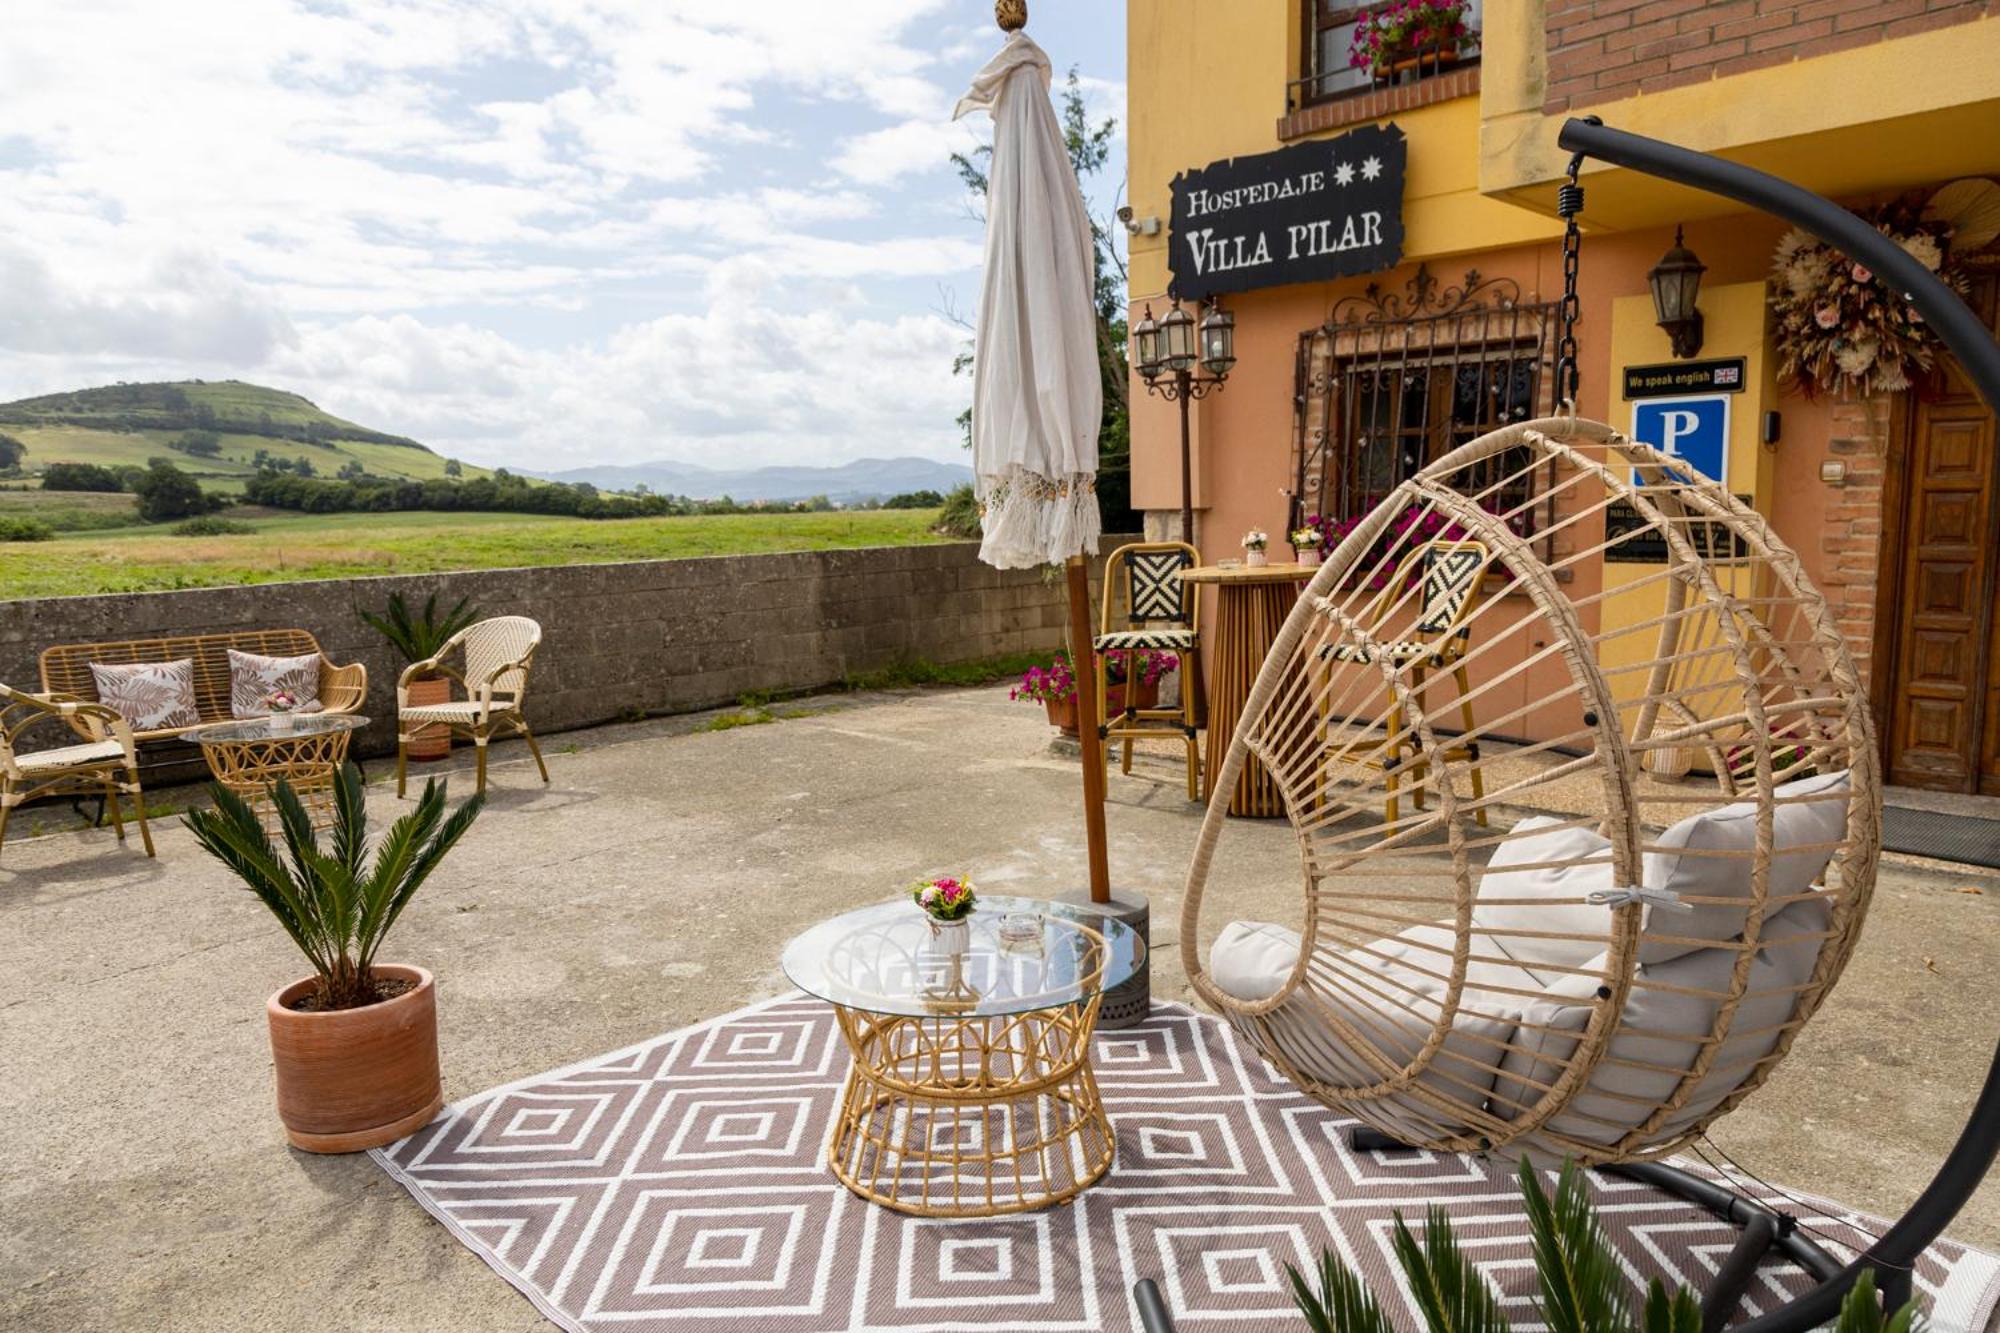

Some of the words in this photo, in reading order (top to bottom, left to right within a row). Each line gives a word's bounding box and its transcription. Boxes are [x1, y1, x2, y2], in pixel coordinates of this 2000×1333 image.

[1185, 227, 1273, 276] VILLA
[1287, 211, 1382, 260] PILAR
[1629, 376, 1643, 388] We
[1646, 374, 1673, 387] speak
[1675, 371, 1710, 385] english
[1658, 411, 1700, 455] P
